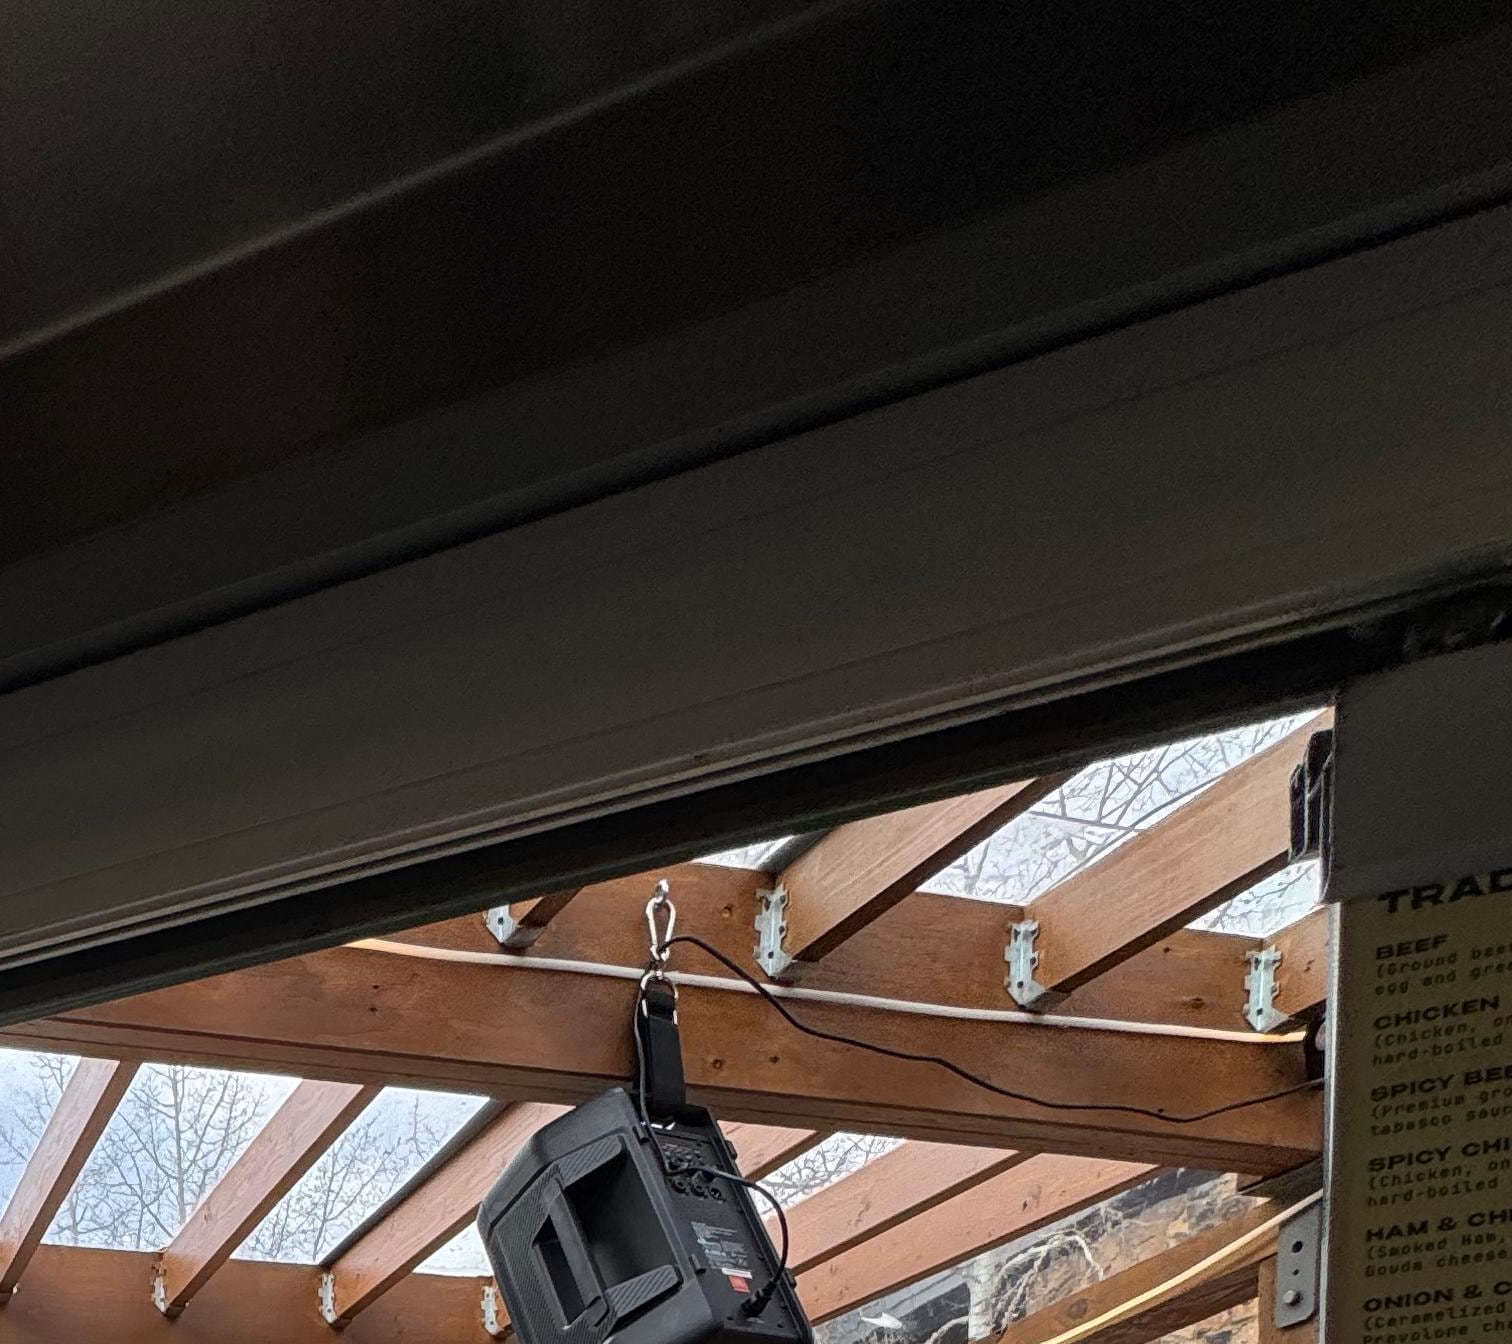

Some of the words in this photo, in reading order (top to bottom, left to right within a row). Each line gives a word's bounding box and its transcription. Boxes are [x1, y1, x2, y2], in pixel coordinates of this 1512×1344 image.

[1376, 934, 1448, 961] BEEF
[1377, 953, 1457, 979] (Ground
[1375, 980, 1409, 995] egg
[1422, 970, 1457, 987] and
[1374, 995, 1500, 1030] CHICKEN
[1373, 1033, 1503, 1066] hard-boiled
[1372, 1074, 1456, 1103] SPICY
[1372, 1096, 1465, 1120] (Premium
[1372, 1114, 1452, 1136] tabasco
[1368, 1146, 1451, 1172] SPICY
[1368, 1177, 1499, 1207] hard-boiled
[1367, 1220, 1428, 1242] HAM
[1438, 1217, 1457, 1231] &
[1368, 1238, 1447, 1260] (Smoked
[1462, 1232, 1505, 1246] Ham,
[1365, 1260, 1424, 1277] Gouda
[1437, 1248, 1508, 1268] cheese
[1363, 1288, 1453, 1313] ONION
[1463, 1284, 1483, 1299] &
[1365, 1302, 1506, 1332] (Caramelized
